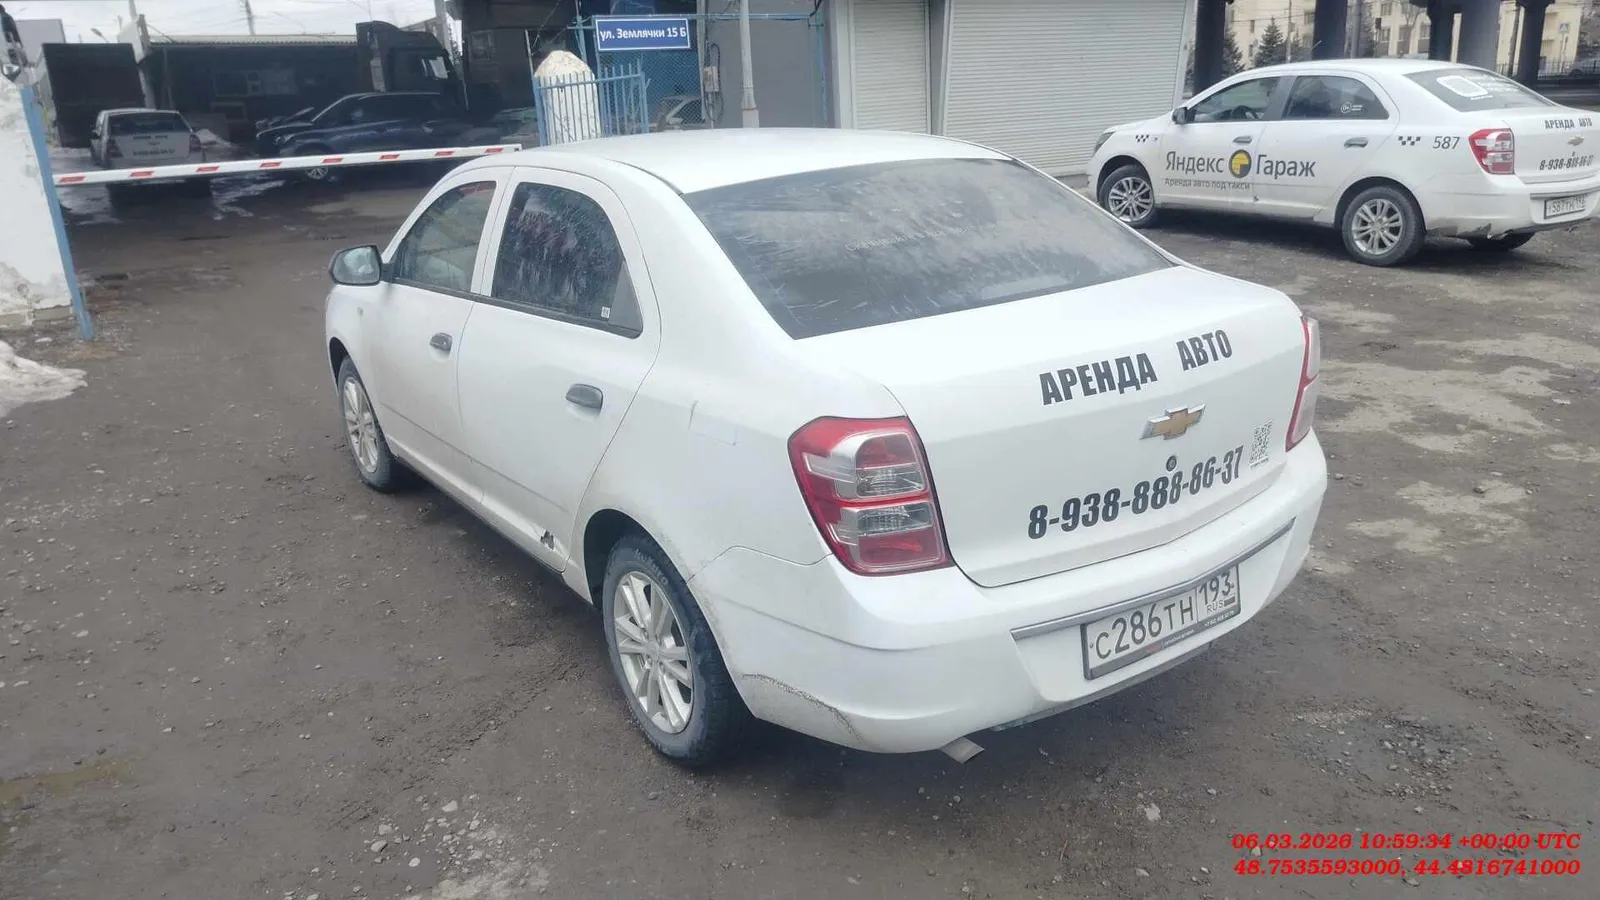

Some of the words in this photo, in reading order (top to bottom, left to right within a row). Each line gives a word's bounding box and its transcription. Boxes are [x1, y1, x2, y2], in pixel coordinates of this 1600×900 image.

[600, 30, 615, 41] ул.
[616, 28, 665, 39] Землячки
[667, 27, 678, 37] 15
[680, 27, 687, 37] Б
[1544, 119, 1575, 129] АРЕНДА
[1432, 136, 1460, 149] 587
[1165, 151, 1224, 174] Яндекс
[1256, 154, 1316, 179] Гараж
[1164, 178, 1192, 187] Аренда
[1211, 180, 1226, 190] под
[1039, 352, 1158, 405] АРЕНДА
[1176, 329, 1233, 371] АВТО
[1027, 445, 1244, 540] 8-938-888-86-37
[1206, 600, 1224, 614] RUS
[1095, 596, 1194, 660] С286ТН
[1198, 572, 1232, 605] 193
